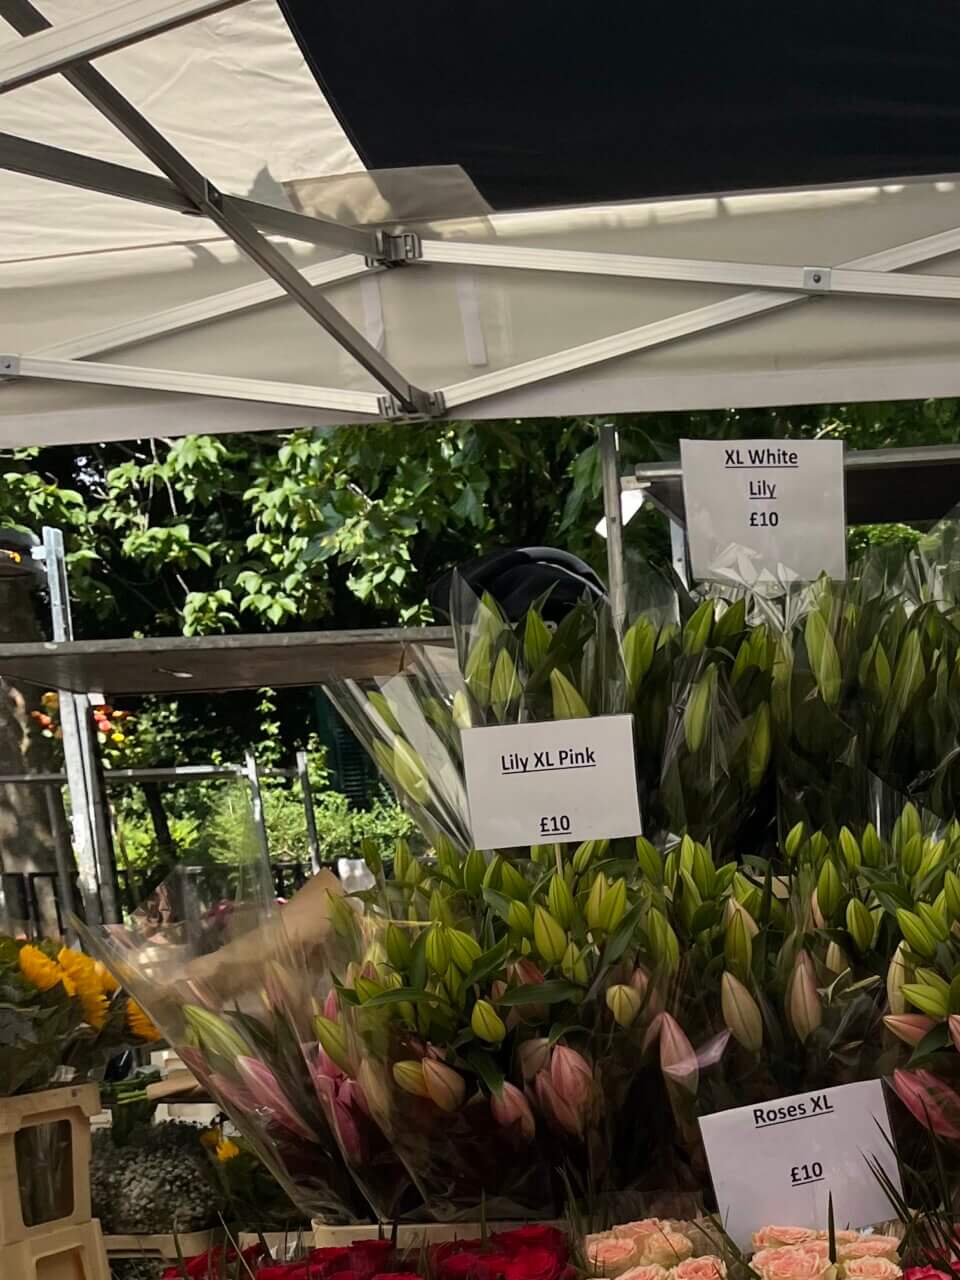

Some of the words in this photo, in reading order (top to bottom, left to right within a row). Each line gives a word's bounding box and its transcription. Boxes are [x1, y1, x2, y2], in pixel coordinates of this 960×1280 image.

[724, 449, 744, 465] XL
[748, 448, 799, 465] White
[748, 480, 777, 499] Lily
[749, 511, 779, 527] £10
[501, 752, 529, 773] Lily
[533, 750, 555, 769] XL
[558, 747, 596, 766] Pink
[539, 815, 571, 834] £10
[752, 1102, 807, 1125] Roses
[809, 1094, 834, 1113] XL
[790, 1161, 823, 1184] £10
